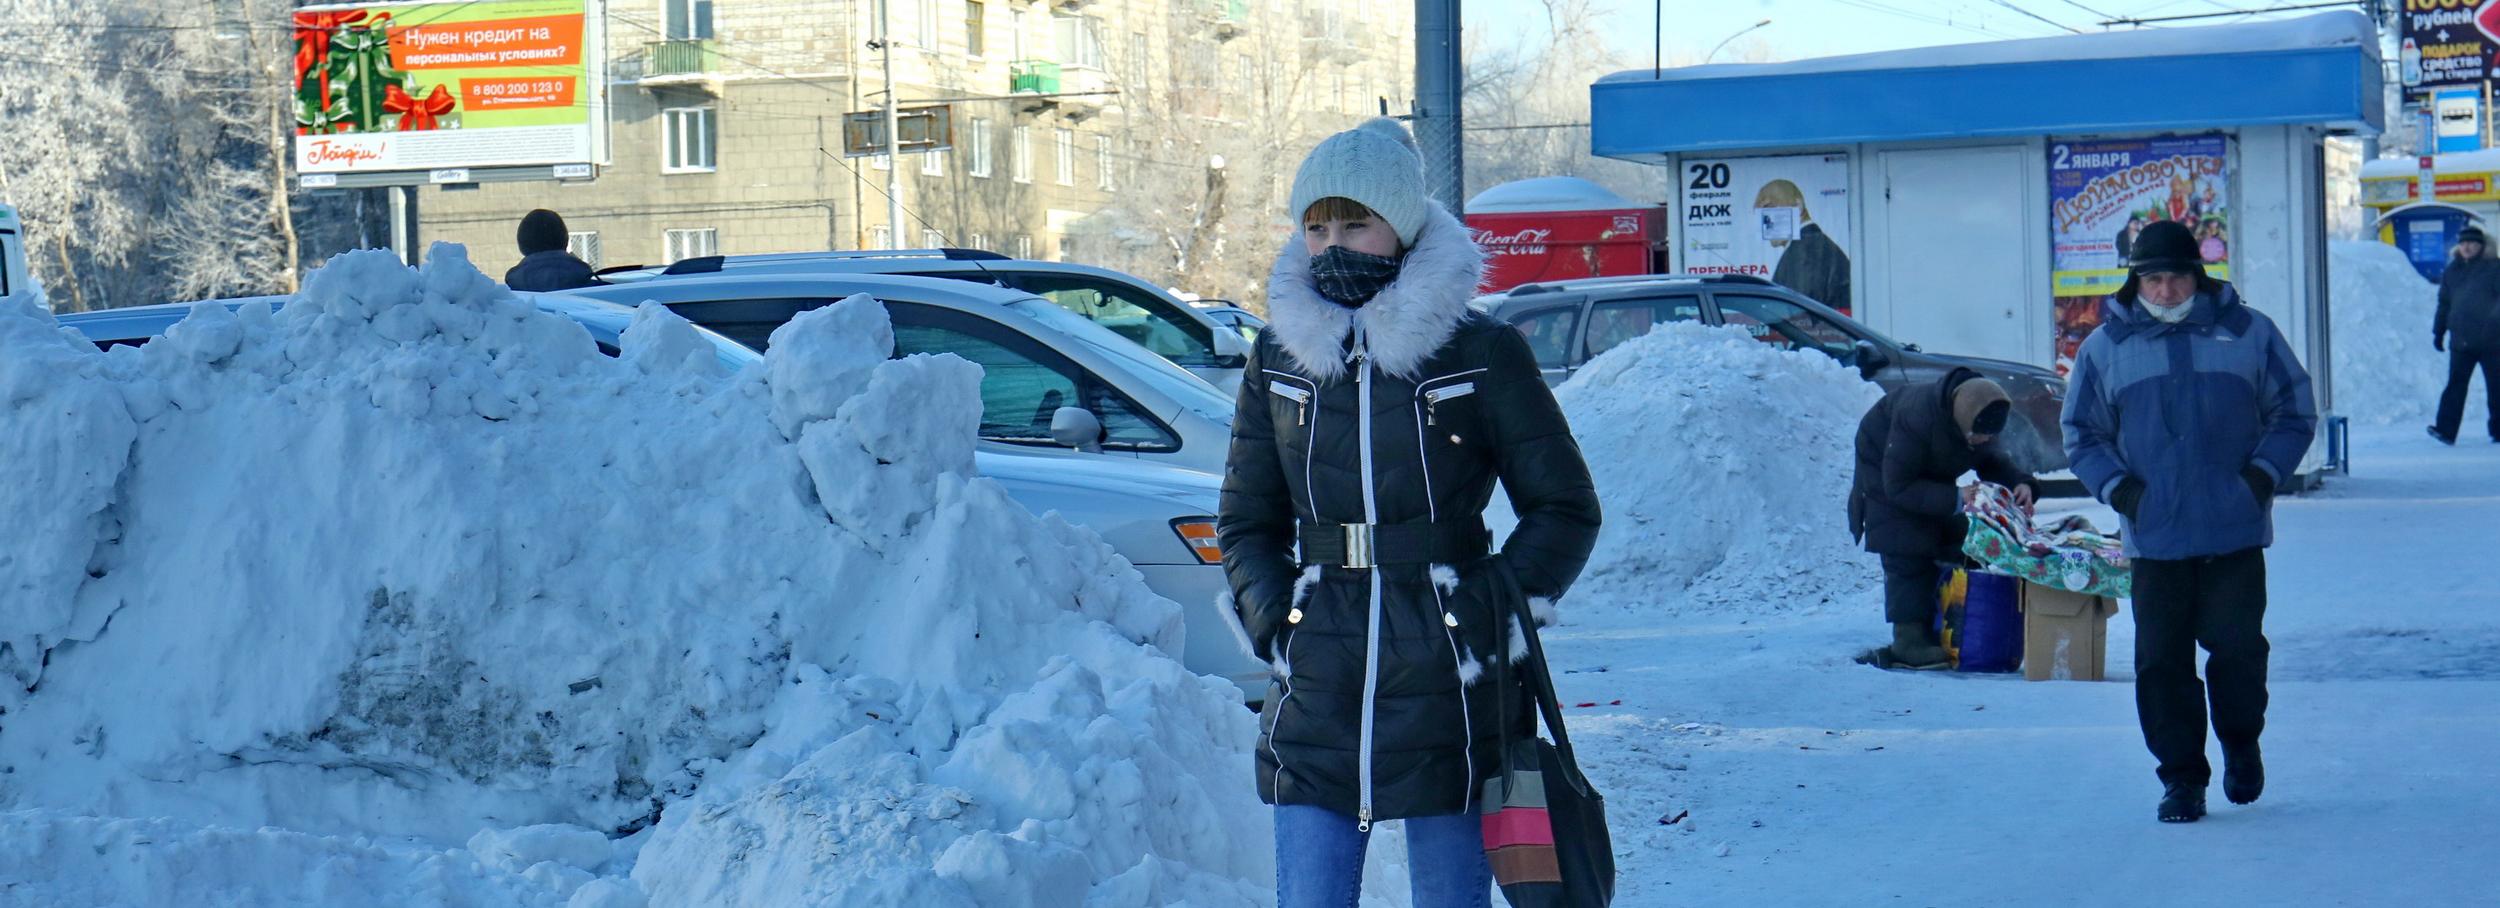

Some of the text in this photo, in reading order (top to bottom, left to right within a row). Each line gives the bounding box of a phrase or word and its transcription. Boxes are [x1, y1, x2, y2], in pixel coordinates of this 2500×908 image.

[2413, 8, 2473, 31] рублей
[405, 27, 550, 50] Нужен кредит на
[405, 46, 566, 66] персональных условиях?
[2422, 42, 2482, 58] ПОДАРОК
[2422, 56, 2482, 71] средство
[473, 82, 563, 96] 8 800 200 123 0
[2053, 145, 2131, 169] 2 ЯНВАРЯ
[1689, 163, 1730, 190] 20
[1689, 192, 1732, 200] февраля
[2054, 154, 2225, 234] ДЮЙМОВОЧКА
[1689, 204, 1732, 220] ДКЖ
